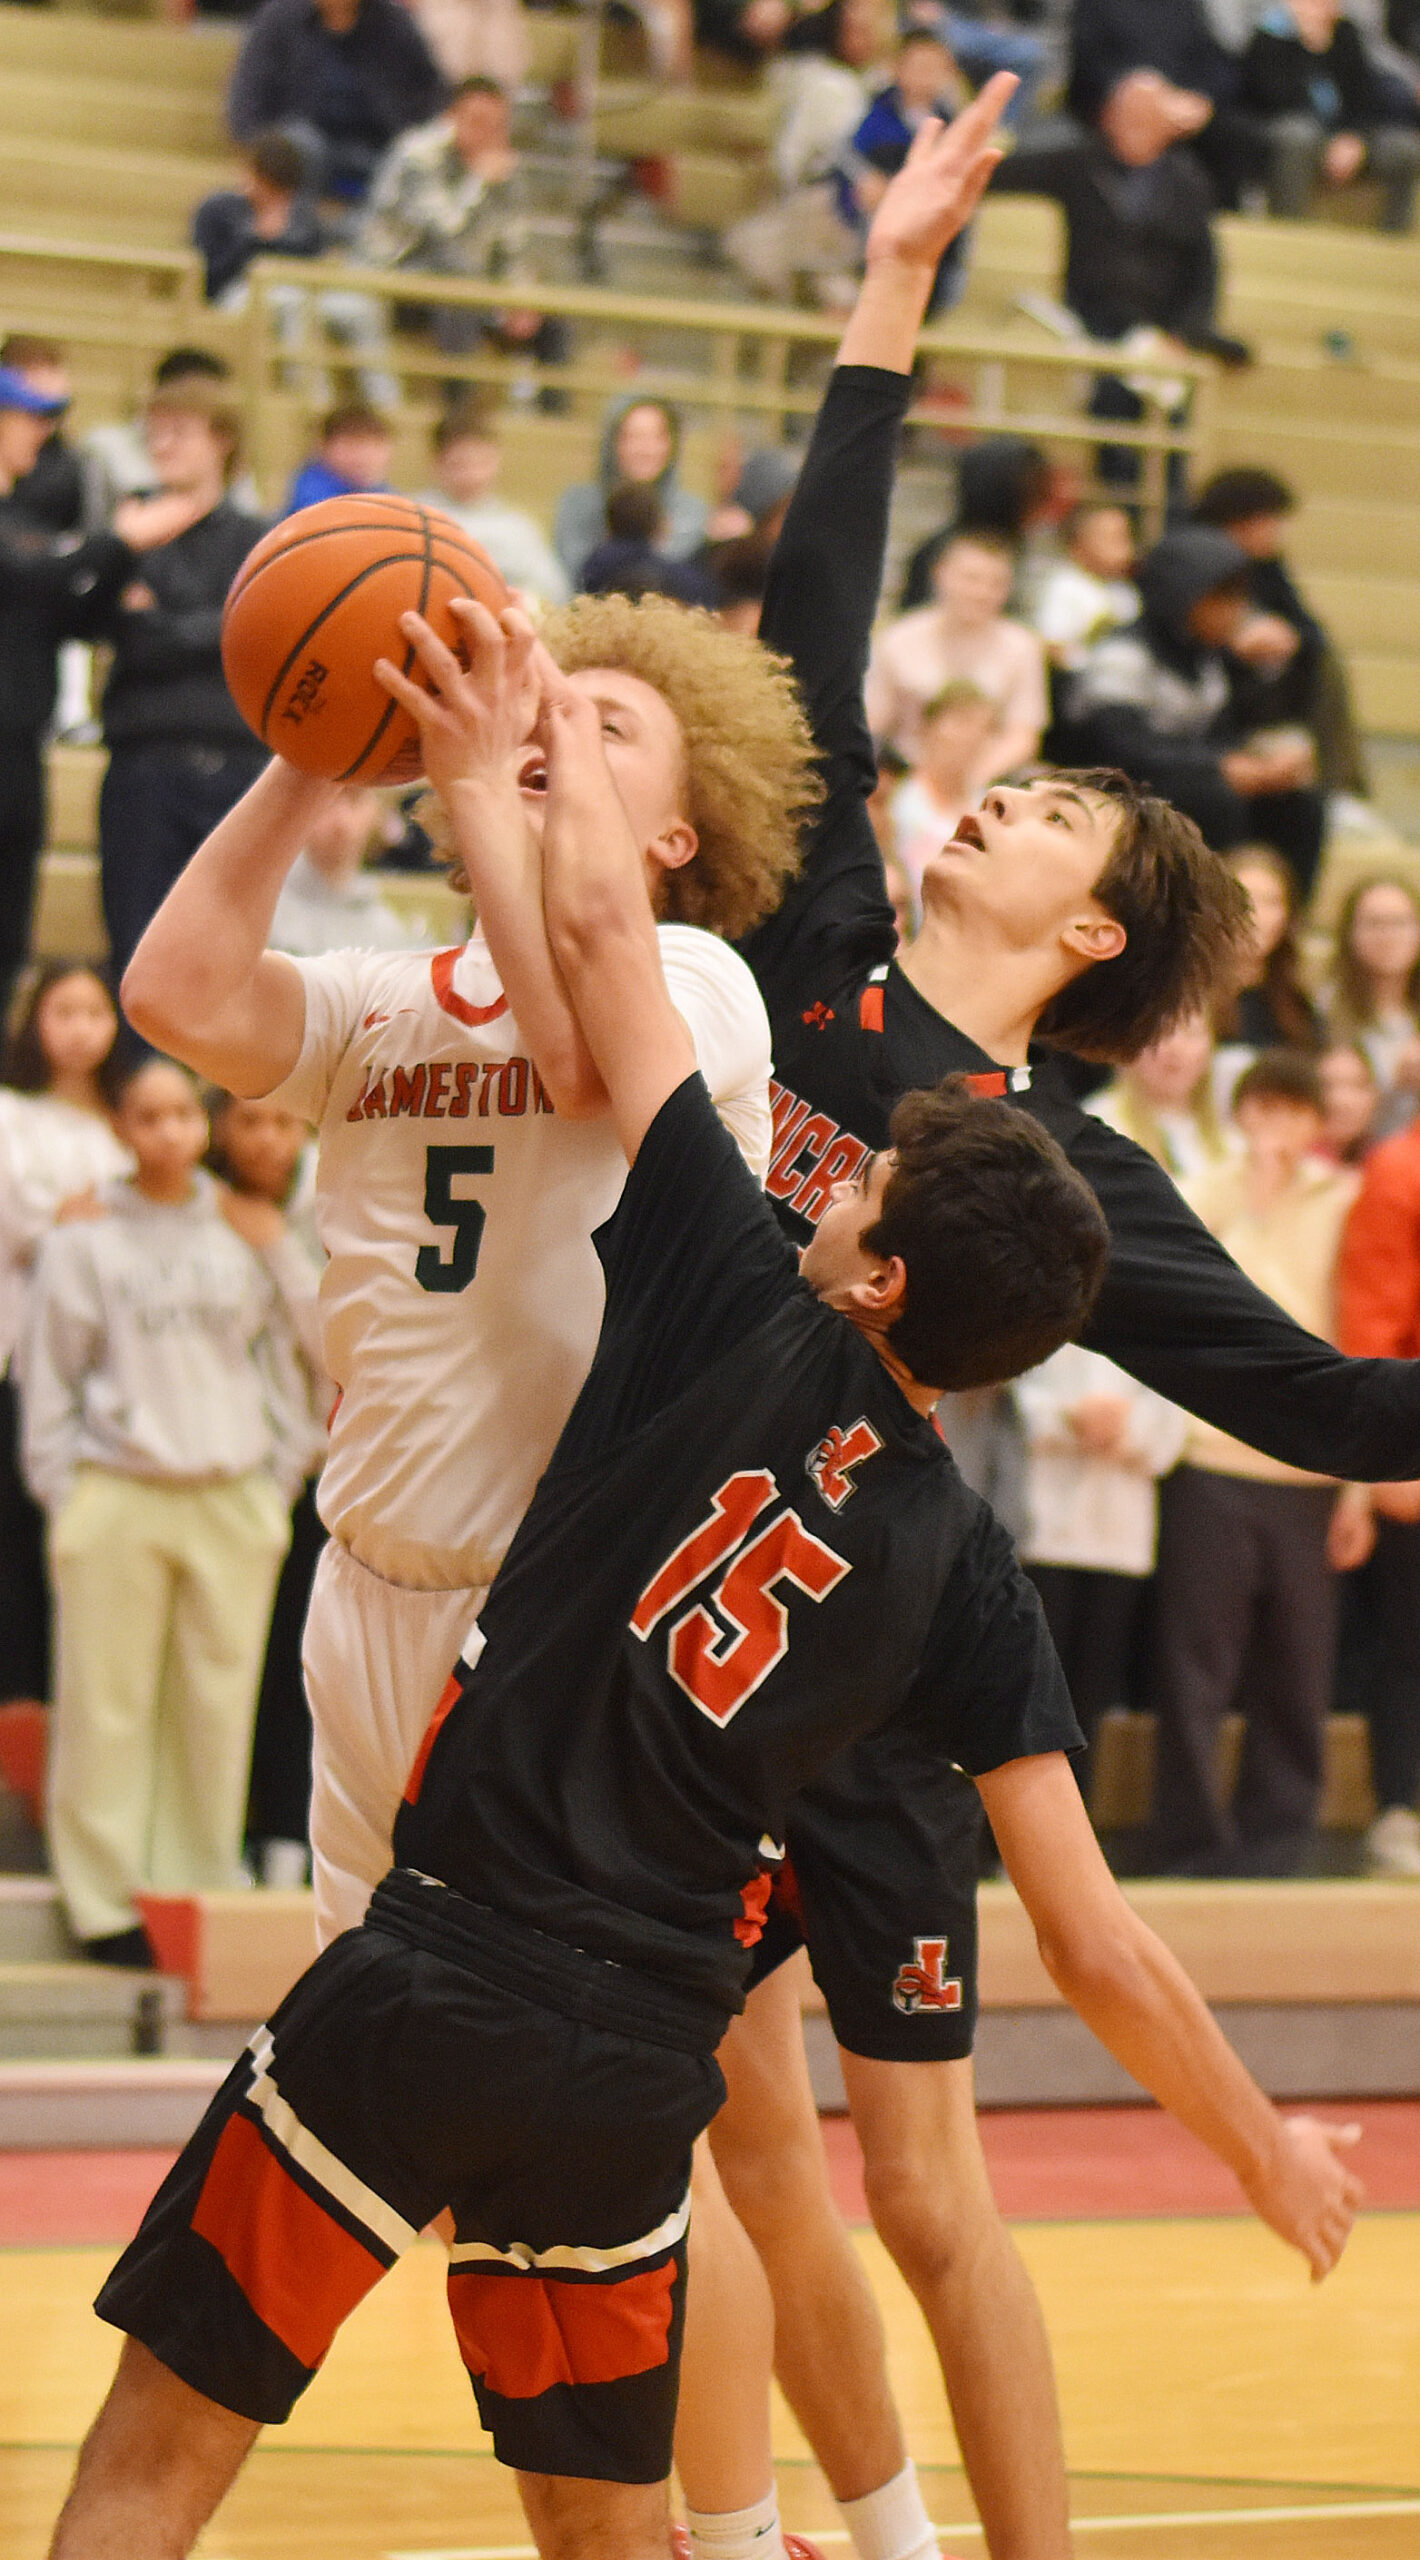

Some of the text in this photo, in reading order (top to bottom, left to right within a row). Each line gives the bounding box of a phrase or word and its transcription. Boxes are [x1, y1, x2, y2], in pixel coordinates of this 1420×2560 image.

[414, 1145, 495, 1293] 5
[628, 1467, 853, 1729] 15
[908, 1935, 963, 2012] L
